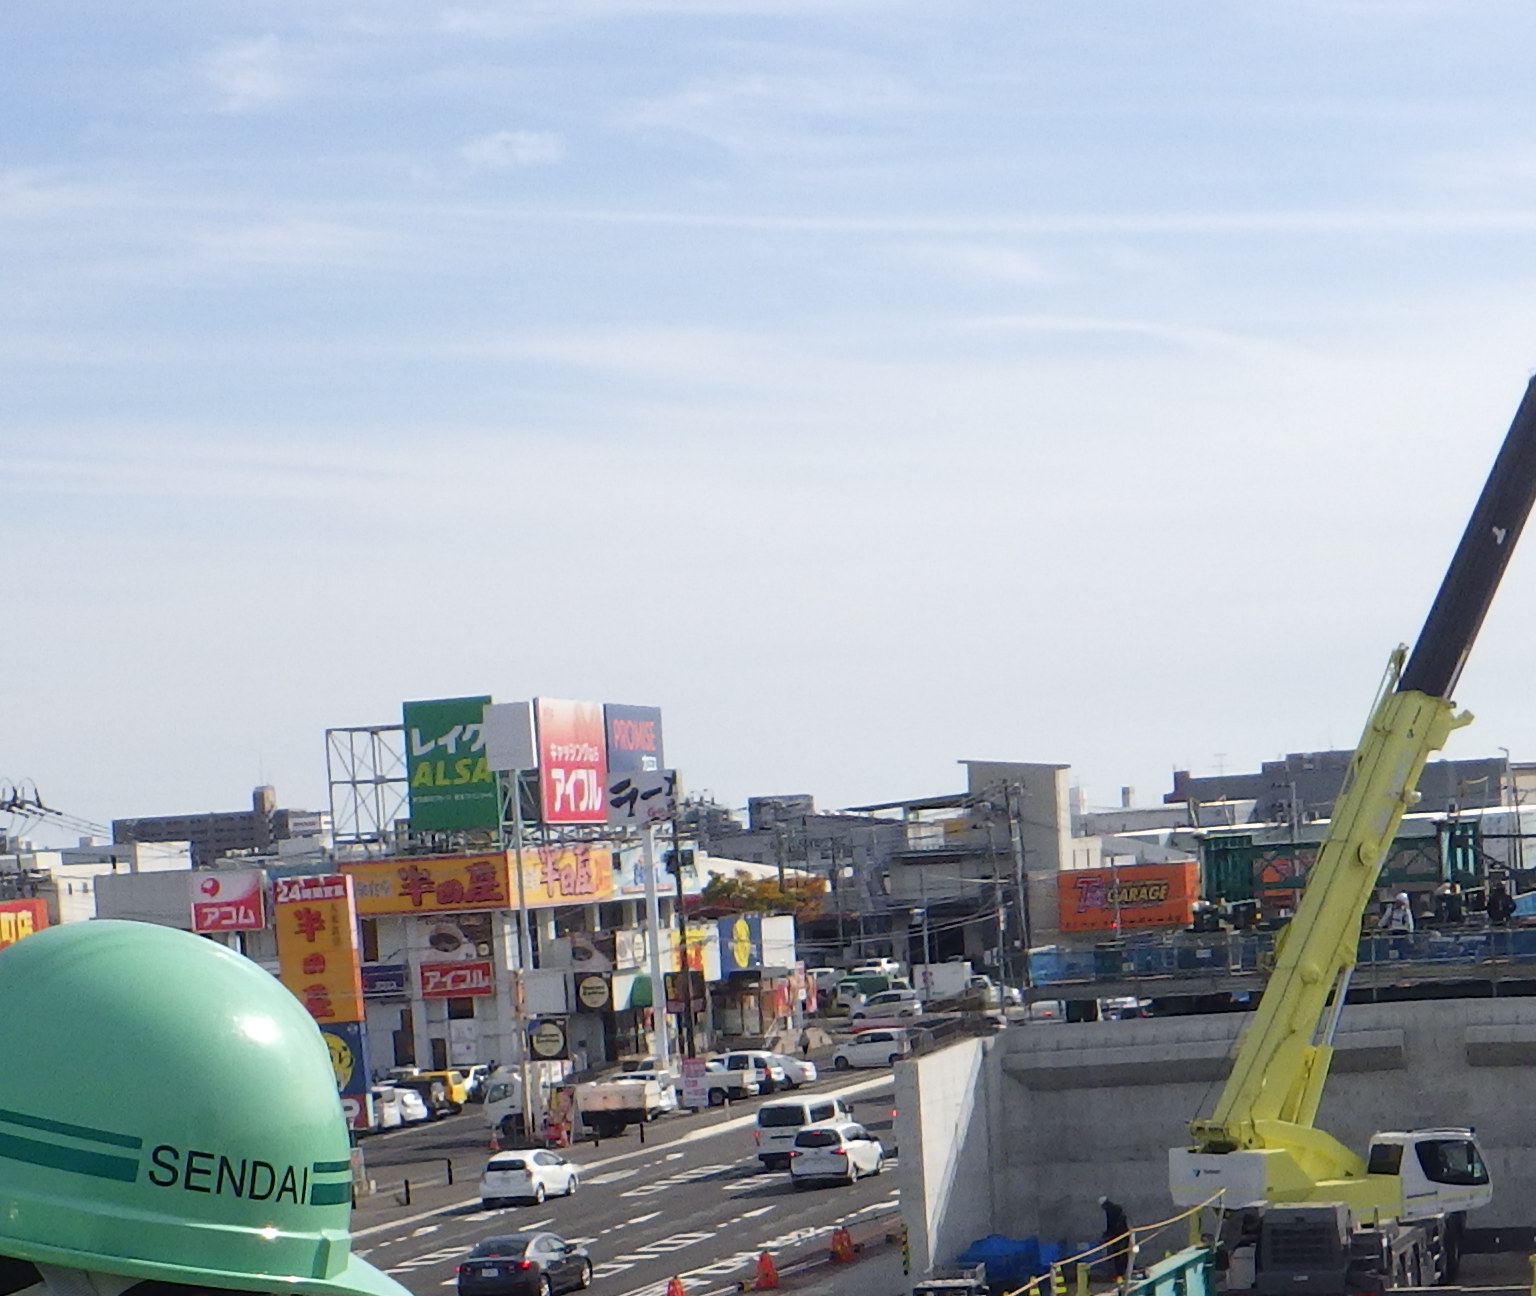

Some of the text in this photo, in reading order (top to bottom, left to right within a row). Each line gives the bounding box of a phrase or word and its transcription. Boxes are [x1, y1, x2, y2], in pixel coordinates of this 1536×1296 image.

[612, 719, 656, 751] PROMISE
[550, 768, 602, 813] アイフル
[1107, 884, 1169, 903] GARAGE
[202, 906, 255, 926] アコム
[423, 972, 490, 991] アイフル
[148, 1144, 309, 1204] SENDAI
